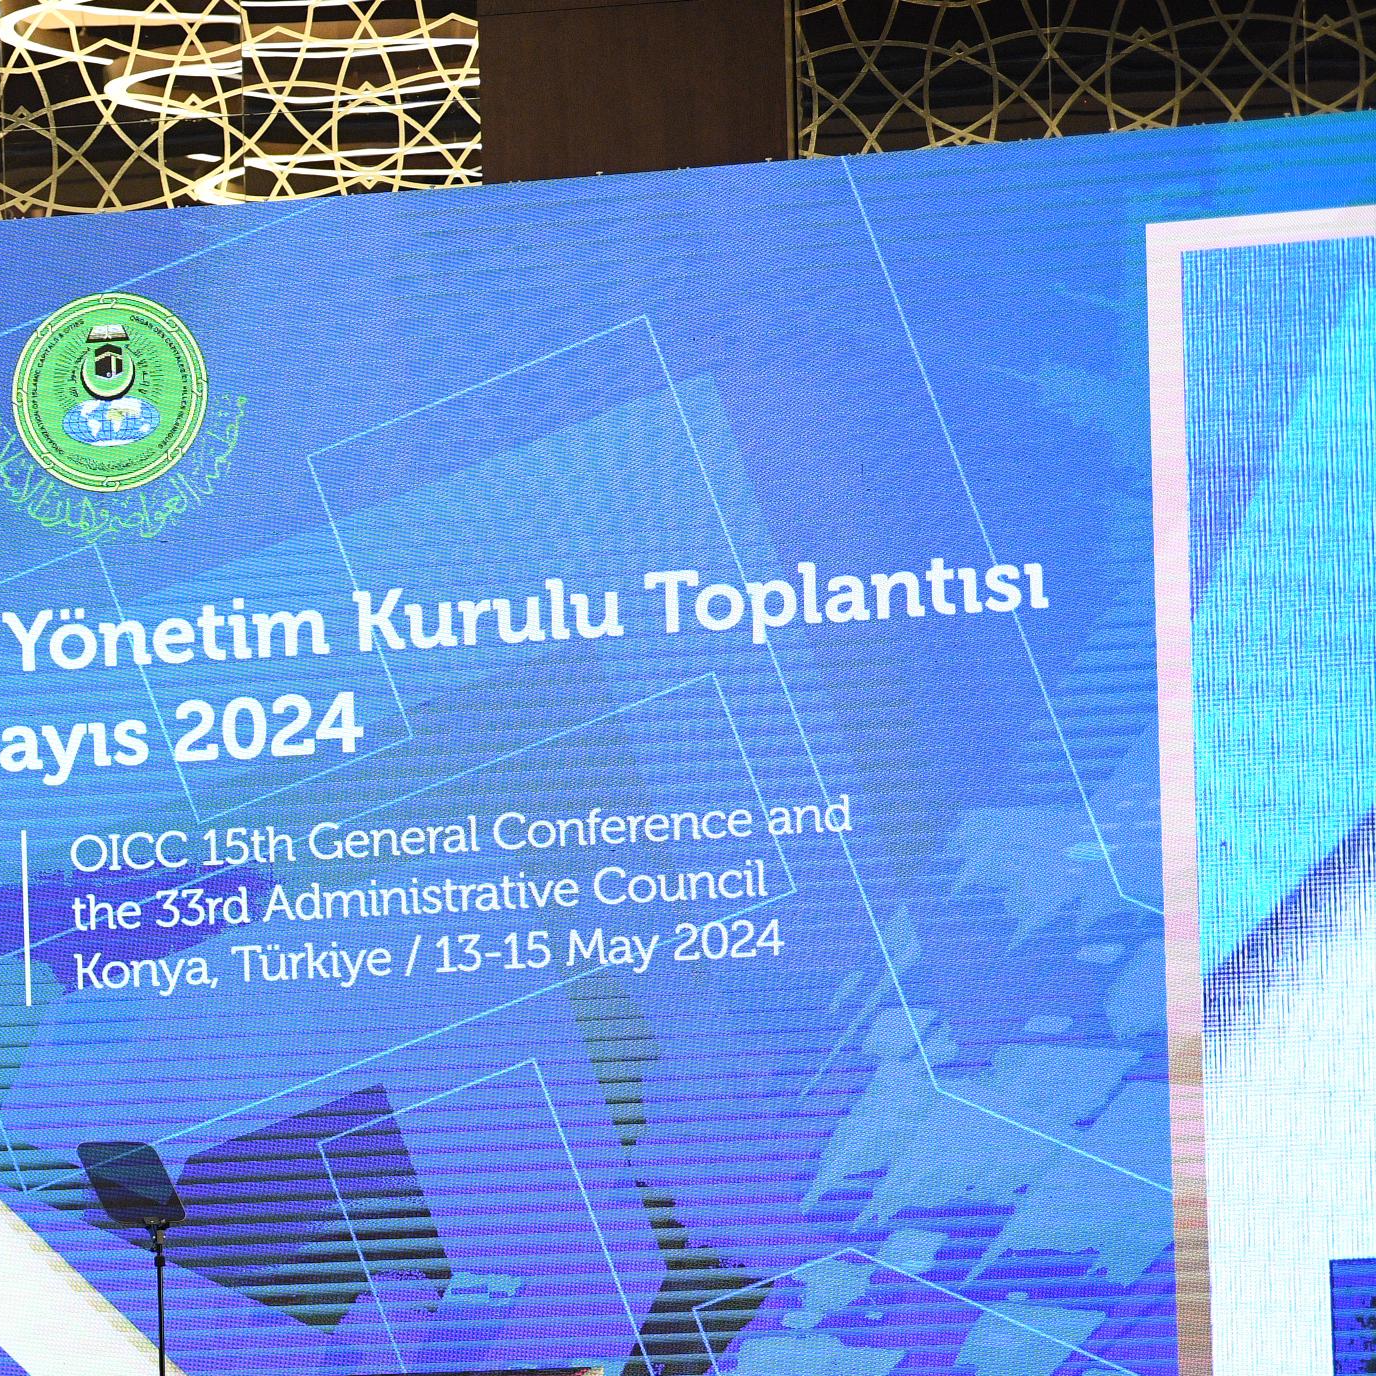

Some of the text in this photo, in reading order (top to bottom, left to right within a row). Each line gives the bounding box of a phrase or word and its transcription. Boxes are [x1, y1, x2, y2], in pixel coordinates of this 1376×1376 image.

[1, 597, 330, 672] Yönetim
[352, 577, 625, 652] Kurulu
[644, 557, 1049, 645] Toplantısı
[172, 691, 365, 763] 2024
[70, 795, 853, 873] OICC 15th General Conference and
[71, 858, 769, 932] the 33rd Administrative Council
[73, 918, 786, 996] Konya, Türkiye / 13-15 May 2024
